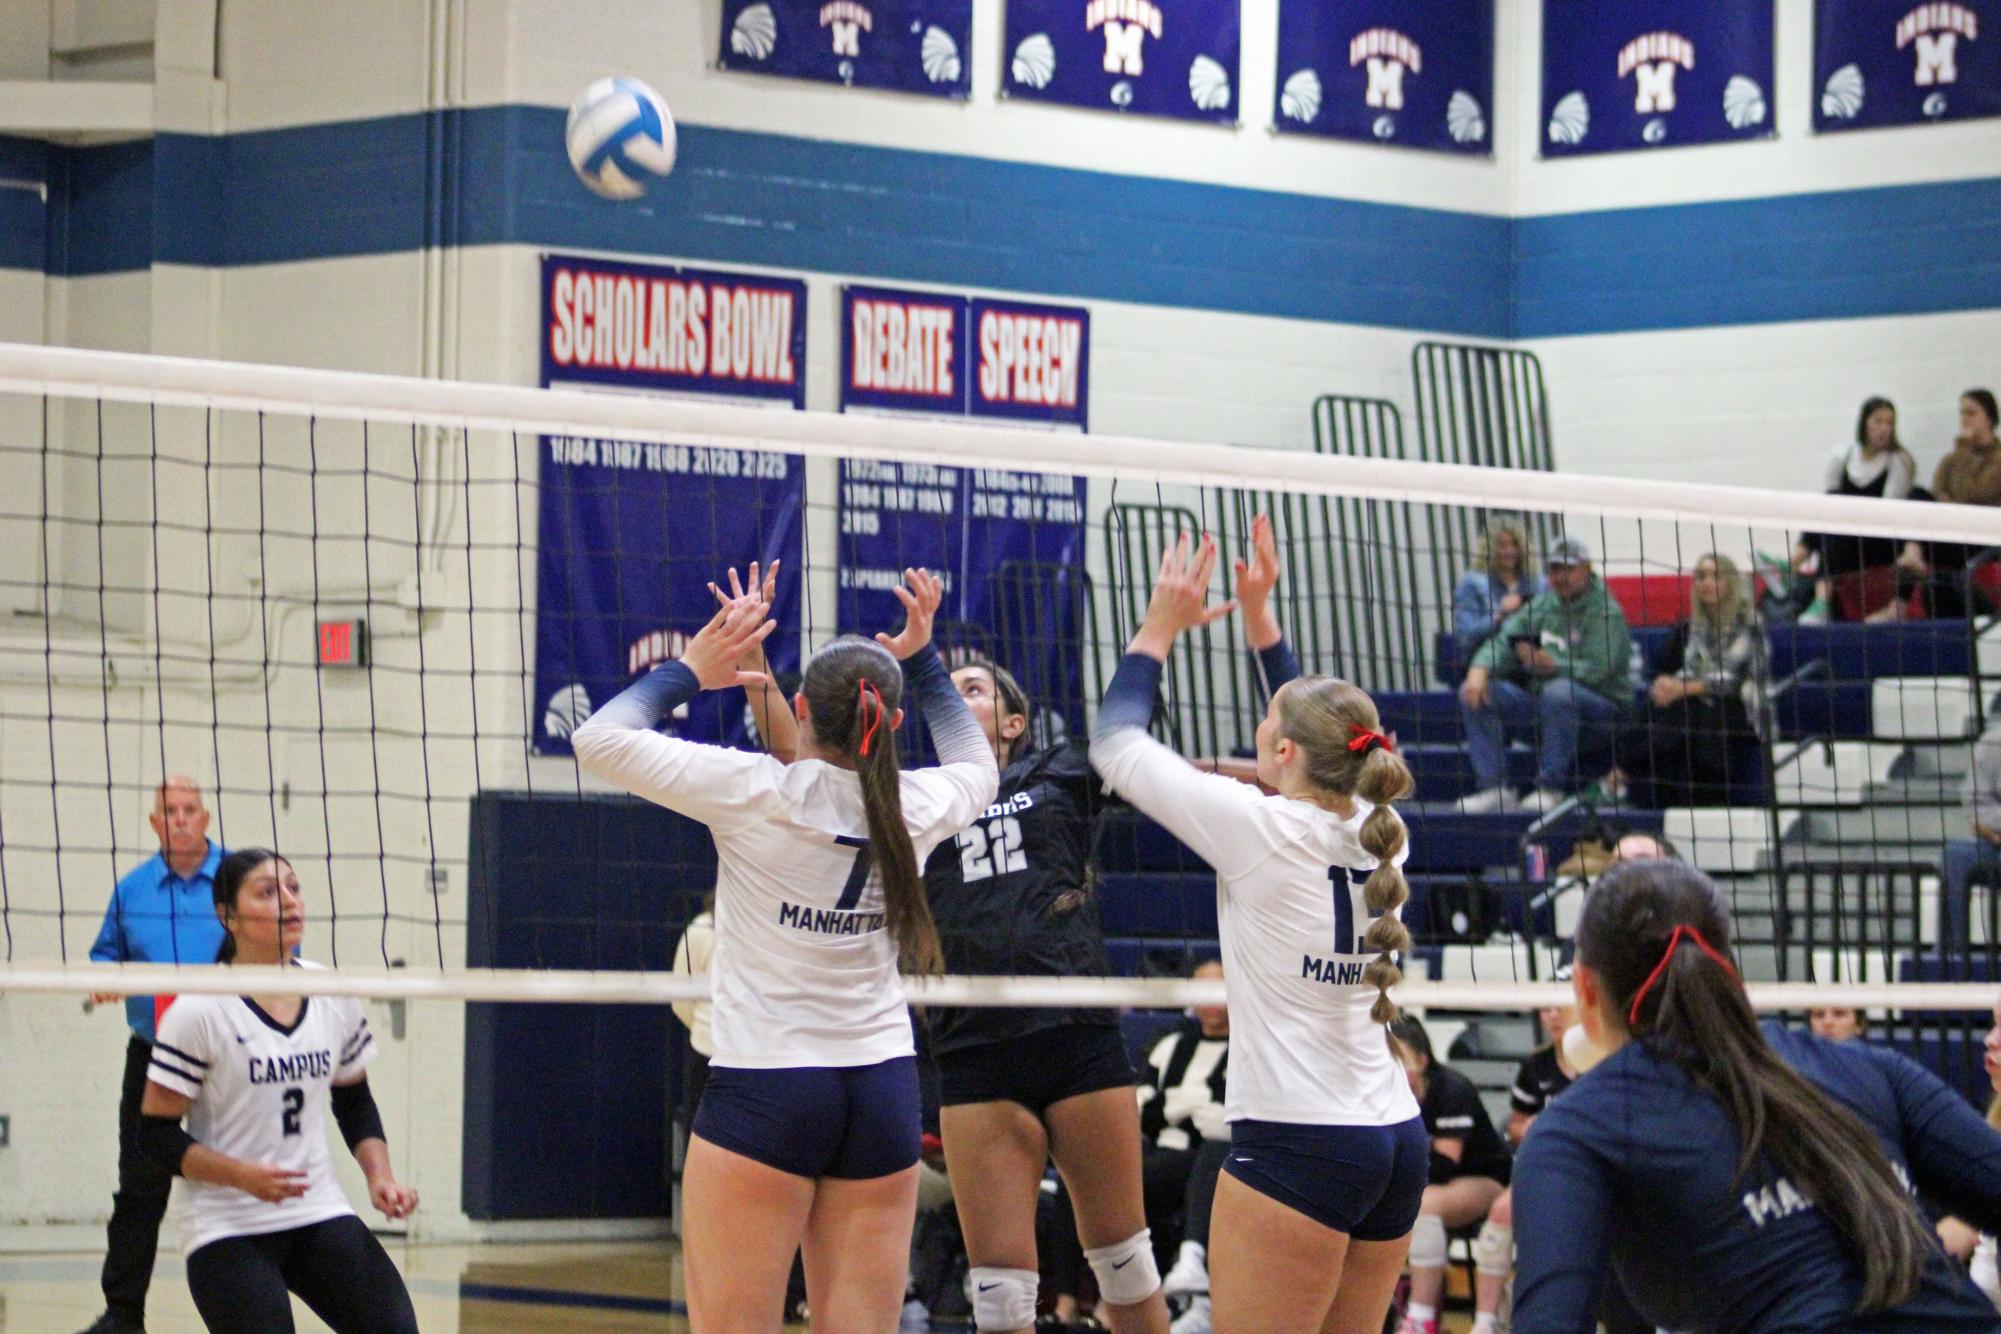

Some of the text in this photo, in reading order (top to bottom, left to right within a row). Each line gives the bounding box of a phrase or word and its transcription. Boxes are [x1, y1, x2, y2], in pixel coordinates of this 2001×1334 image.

[1103, 20, 1144, 77] M
[1914, 32, 1957, 87] M
[1365, 57, 1405, 110] M
[1634, 61, 1677, 114] M
[552, 268, 794, 384] SCHOLARS BOWL
[853, 299, 953, 397] DEBATE
[980, 308, 1081, 409] SPEECH
[834, 835, 877, 910] 7
[954, 816, 1028, 883] 22
[250, 1050, 331, 1084] CAMPUS
[283, 1087, 304, 1138] 2
